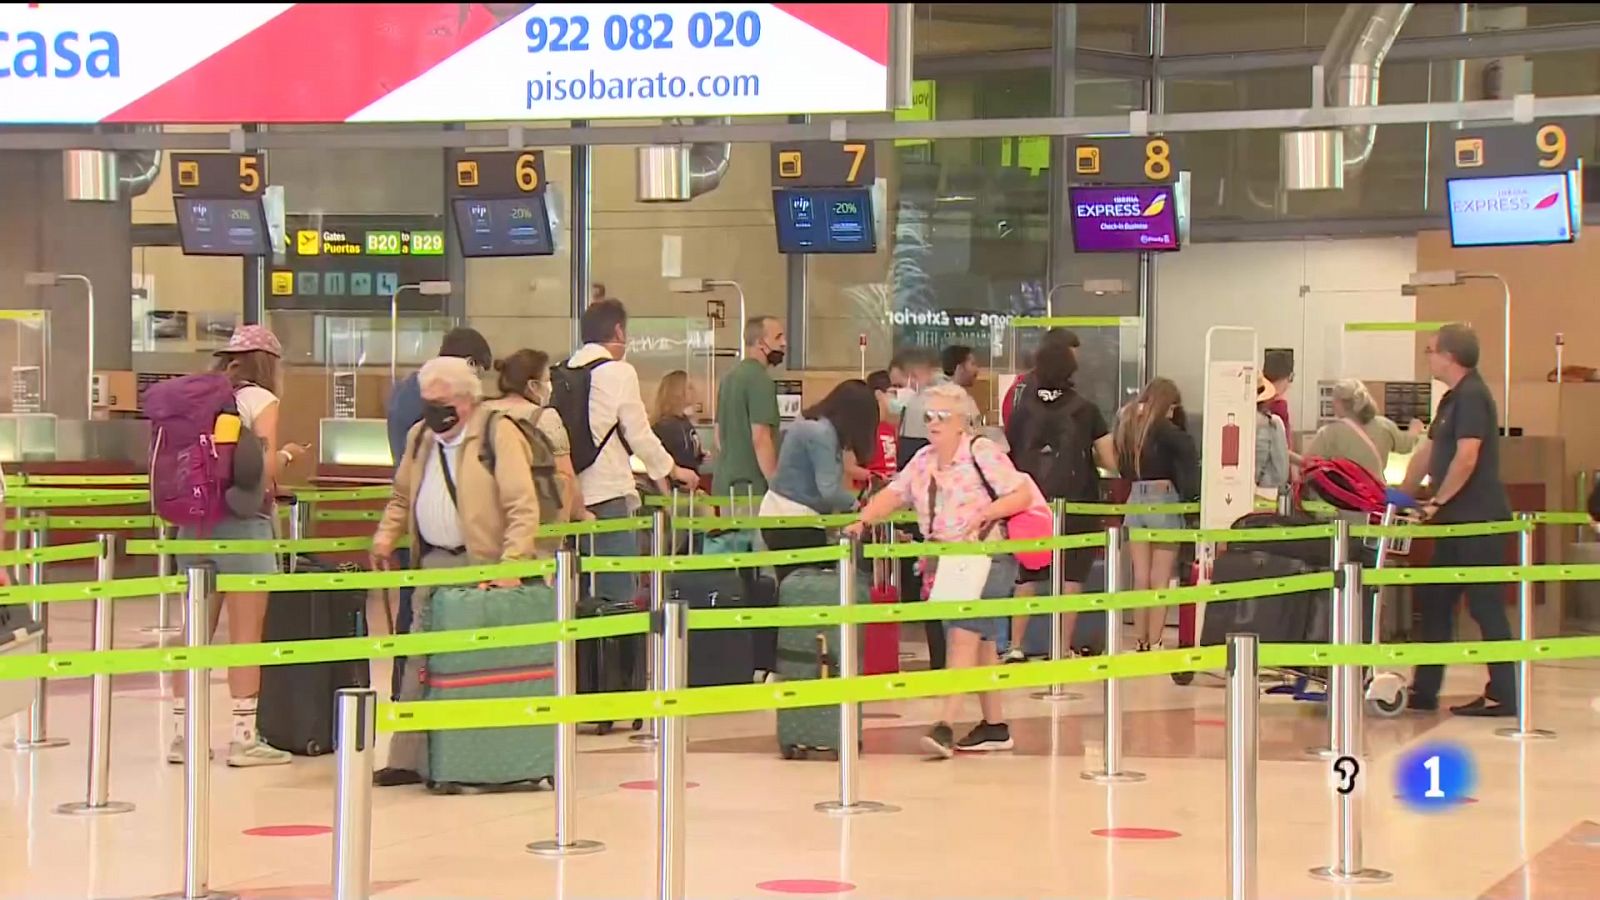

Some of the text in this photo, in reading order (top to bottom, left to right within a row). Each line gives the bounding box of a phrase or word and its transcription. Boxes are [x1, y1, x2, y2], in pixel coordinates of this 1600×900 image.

[525, 10, 761, 53] 922 082 020
[526, 69, 760, 110] pisobarato.com
[1536, 124, 1567, 168] 9
[843, 144, 866, 182] 7
[1144, 139, 1170, 180] 8
[239, 156, 260, 192] 5
[515, 153, 538, 191] 6
[793, 197, 810, 212] vip
[832, 202, 857, 214] -20%
[1077, 203, 1141, 217] EXPRESS
[1453, 196, 1530, 213] EXPRESS
[322, 231, 346, 241] Gates
[367, 234, 398, 251] B20
[401, 231, 410, 241] to
[412, 234, 443, 250] B29
[323, 242, 361, 254] Puertas
[401, 244, 409, 253] a
